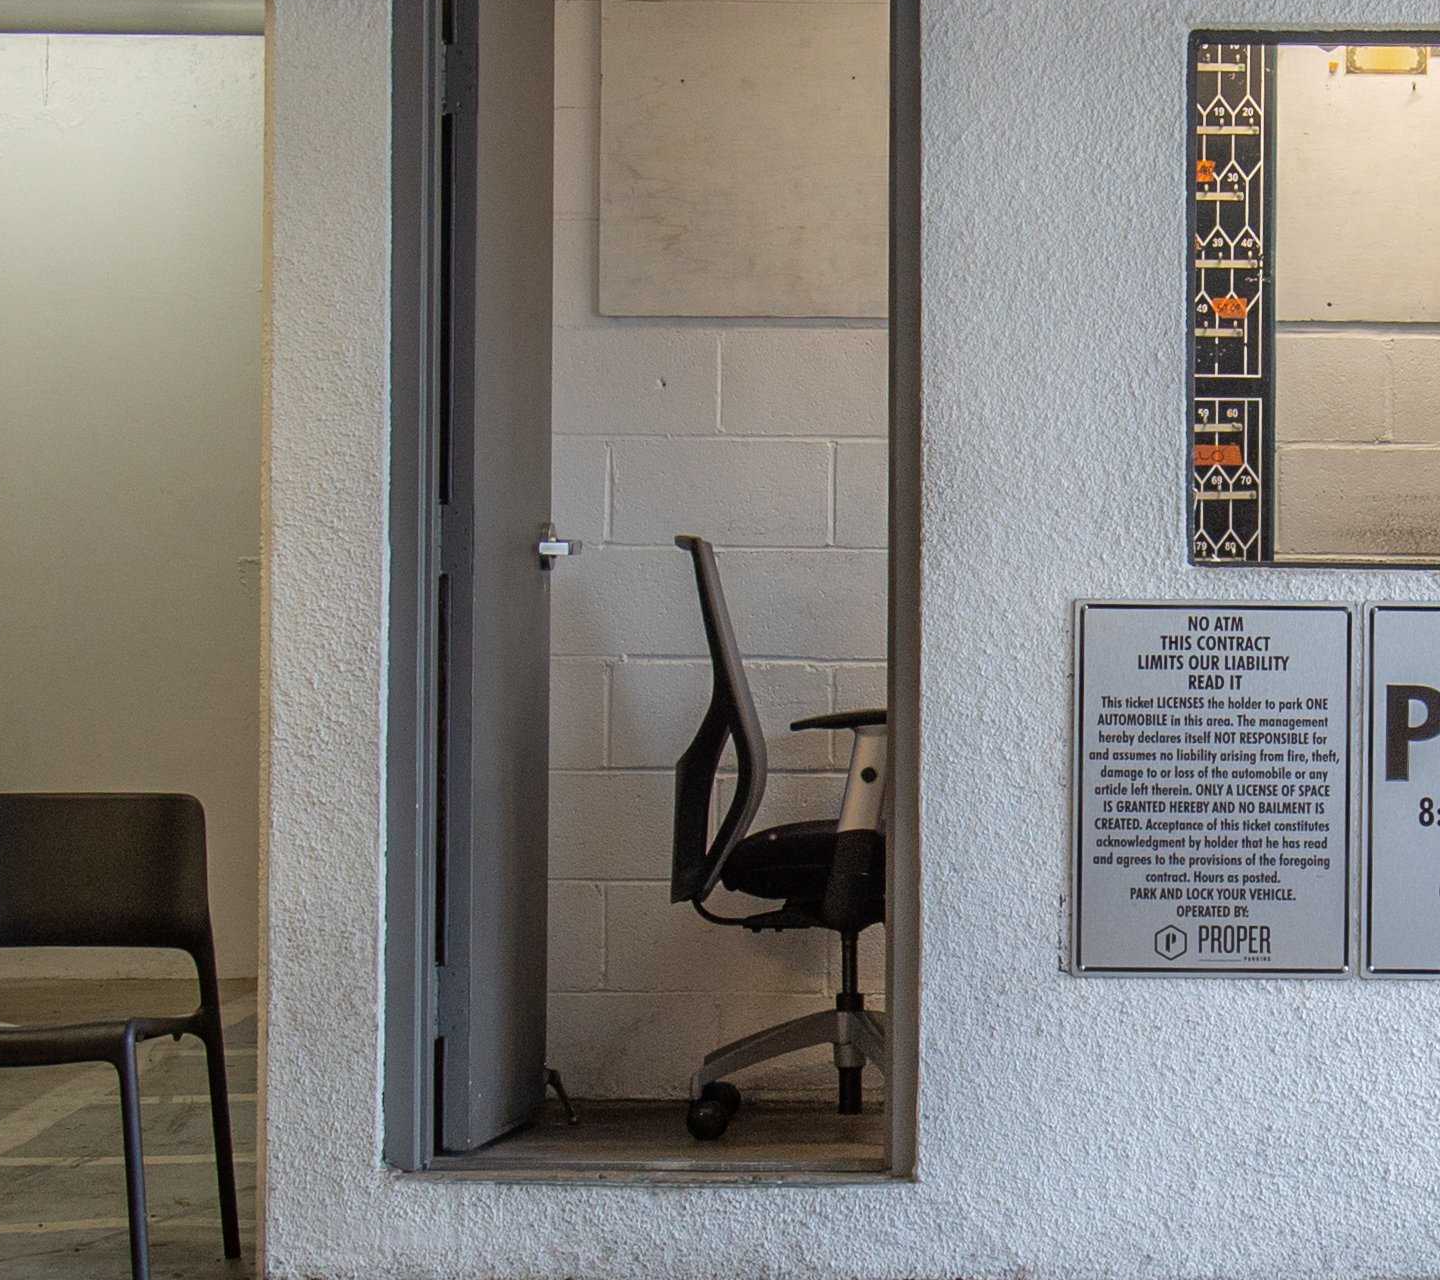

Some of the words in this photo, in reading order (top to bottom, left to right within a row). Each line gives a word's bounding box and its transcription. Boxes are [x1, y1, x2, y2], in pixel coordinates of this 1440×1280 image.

[1188, 616, 1210, 631] NO
[1214, 616, 1244, 632] ATM
[1160, 635, 1192, 651] THIS
[1197, 635, 1271, 651] CONTRACT
[1138, 654, 1184, 670] LIMITS
[1188, 655, 1220, 671] OUR
[1224, 655, 1289, 671] LIABILITY
[1188, 674, 1225, 690] READ
[1230, 675, 1242, 690] IT
[1101, 696, 1122, 709] This
[1125, 696, 1154, 709] ticket
[1157, 696, 1205, 709] LICENSES
[1207, 696, 1225, 709] the
[1228, 696, 1262, 710] holder
[1265, 699, 1275, 710] to
[1279, 697, 1303, 712] park
[1306, 698, 1328, 710] ONE
[1097, 713, 1167, 726] AUTOMOBILE
[1170, 714, 1181, 726] in
[1184, 713, 1203, 727] this
[1206, 718, 1234, 727] area.
[1237, 714, 1256, 727] The
[1259, 717, 1328, 729] management
[1098, 731, 1135, 746] hereby
[1138, 731, 1181, 744] declares
[1185, 731, 1211, 744] itself
[1214, 731, 1236, 744] NOT
[1239, 732, 1309, 745] RESPONSIBLE
[1312, 732, 1327, 745] for
[1176, 905, 1231, 918] OPERATED
[1234, 905, 1249, 918] BY:
[1198, 925, 1271, 954] PROPER
